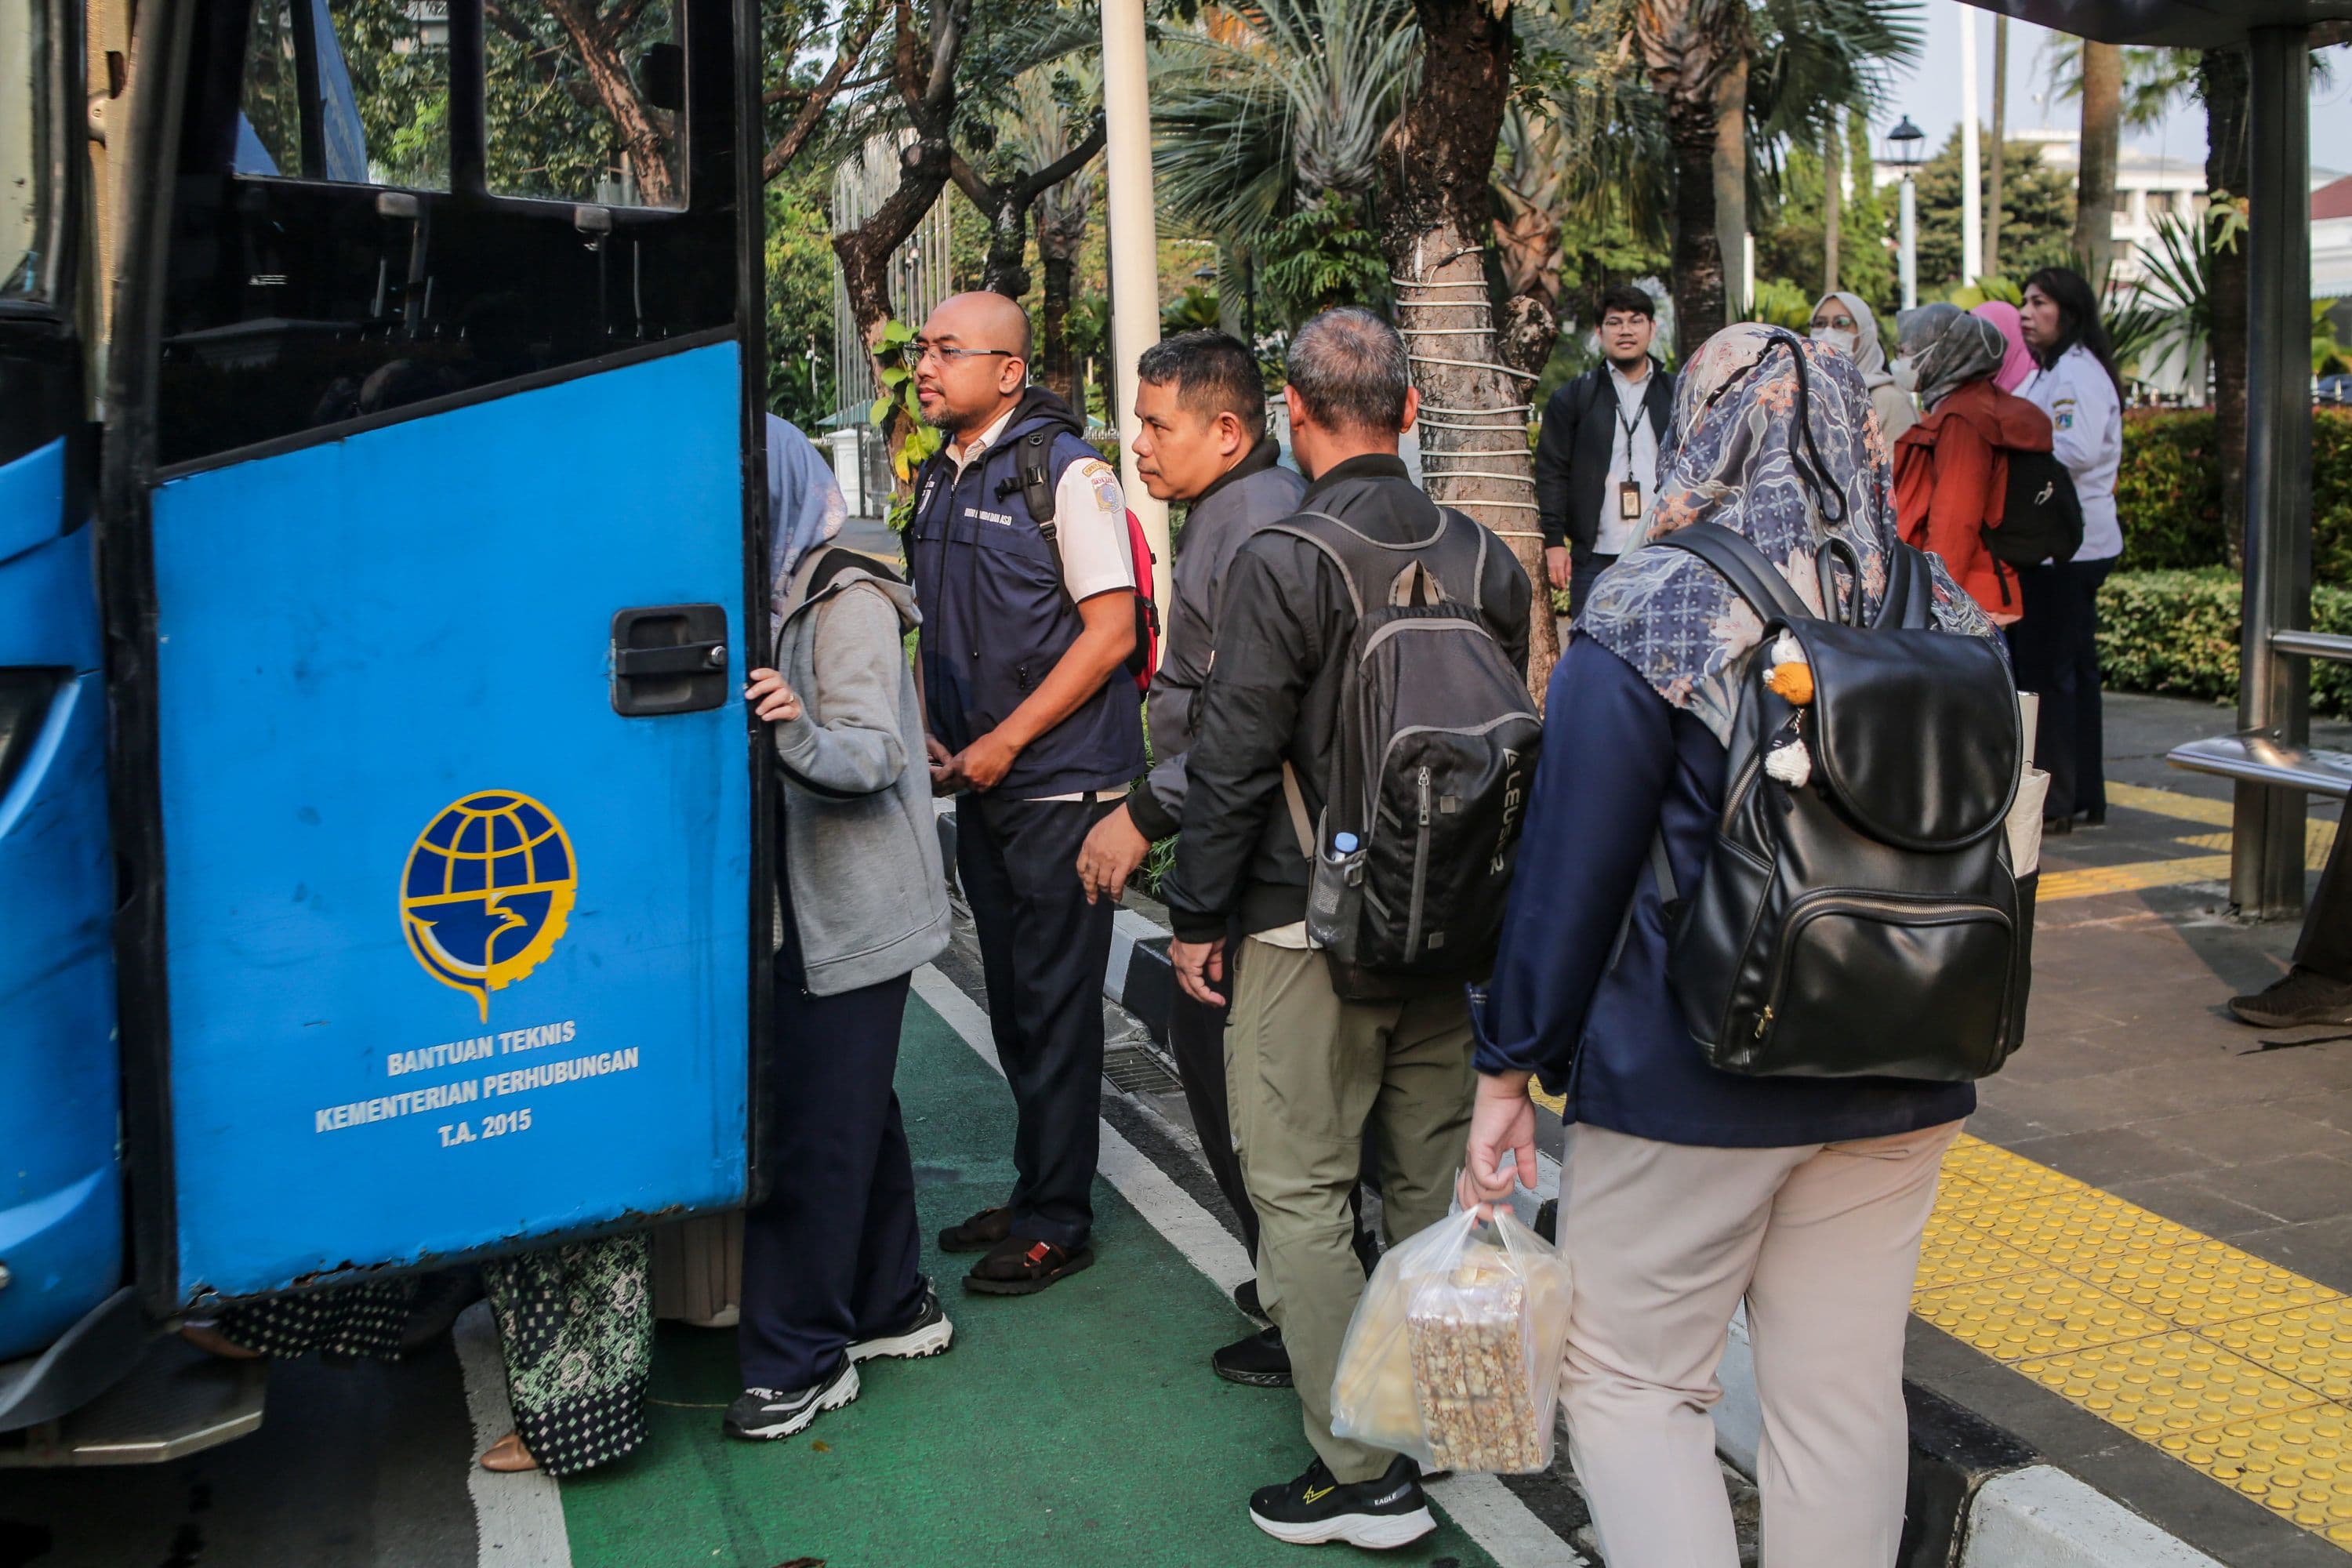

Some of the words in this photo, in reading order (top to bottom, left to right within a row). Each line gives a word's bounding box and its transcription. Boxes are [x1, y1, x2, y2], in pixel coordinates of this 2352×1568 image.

[388, 1035, 494, 1077] BANTUAN
[497, 1020, 575, 1055] TEKNIS
[315, 1079, 478, 1134] KEMENTERIAN
[483, 1047, 639, 1099] PERHUBUNGAN
[437, 1121, 477, 1149] T.A.
[481, 1108, 532, 1139] 2015
